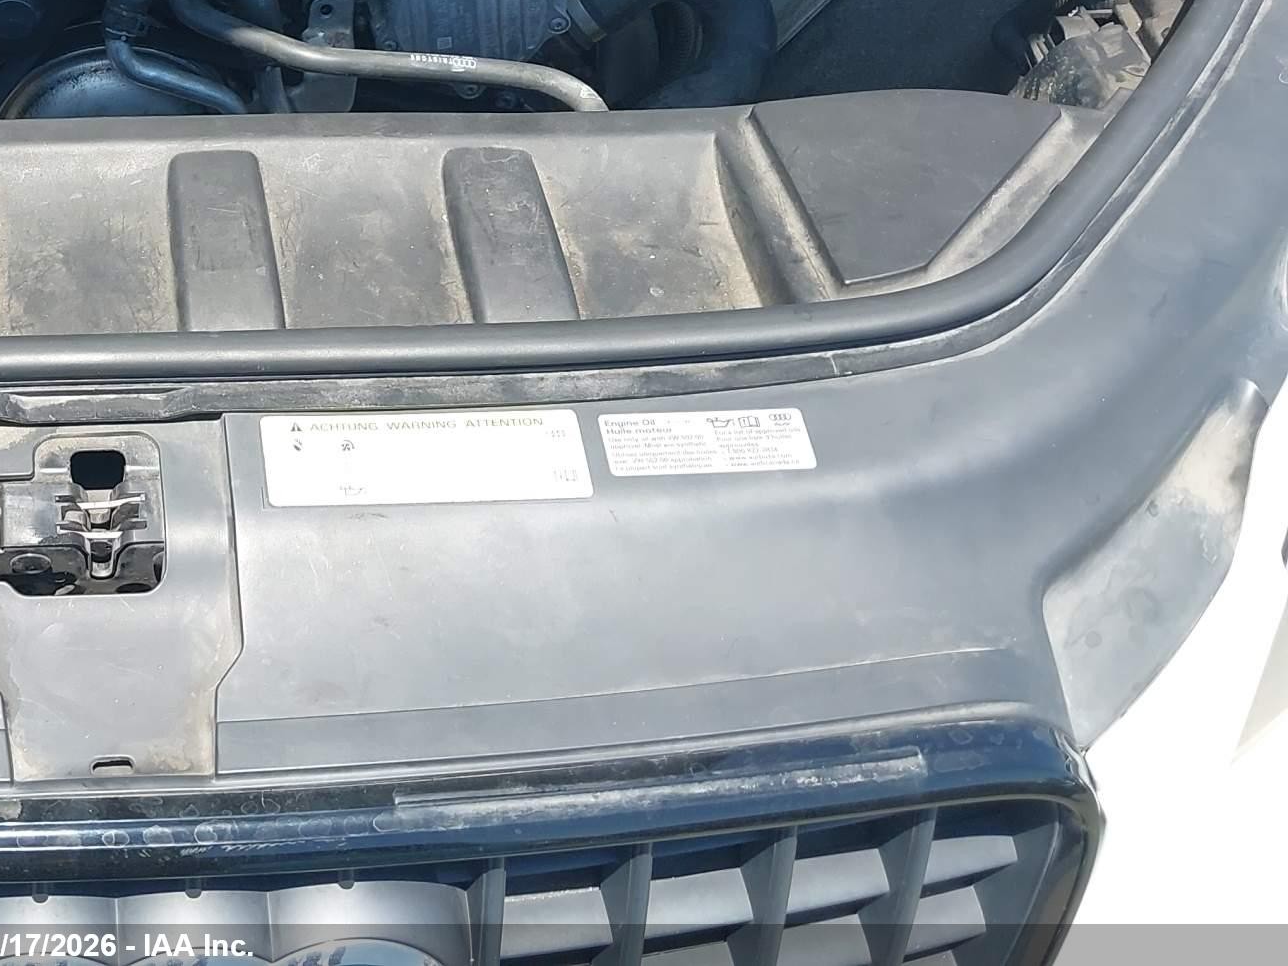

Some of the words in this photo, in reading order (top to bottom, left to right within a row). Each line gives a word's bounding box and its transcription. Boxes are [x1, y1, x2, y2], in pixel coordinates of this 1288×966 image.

[309, 421, 379, 432] ACHTUNG
[386, 419, 457, 430] WARNING
[464, 417, 545, 427] ATTENTION
[604, 419, 639, 427] Engine
